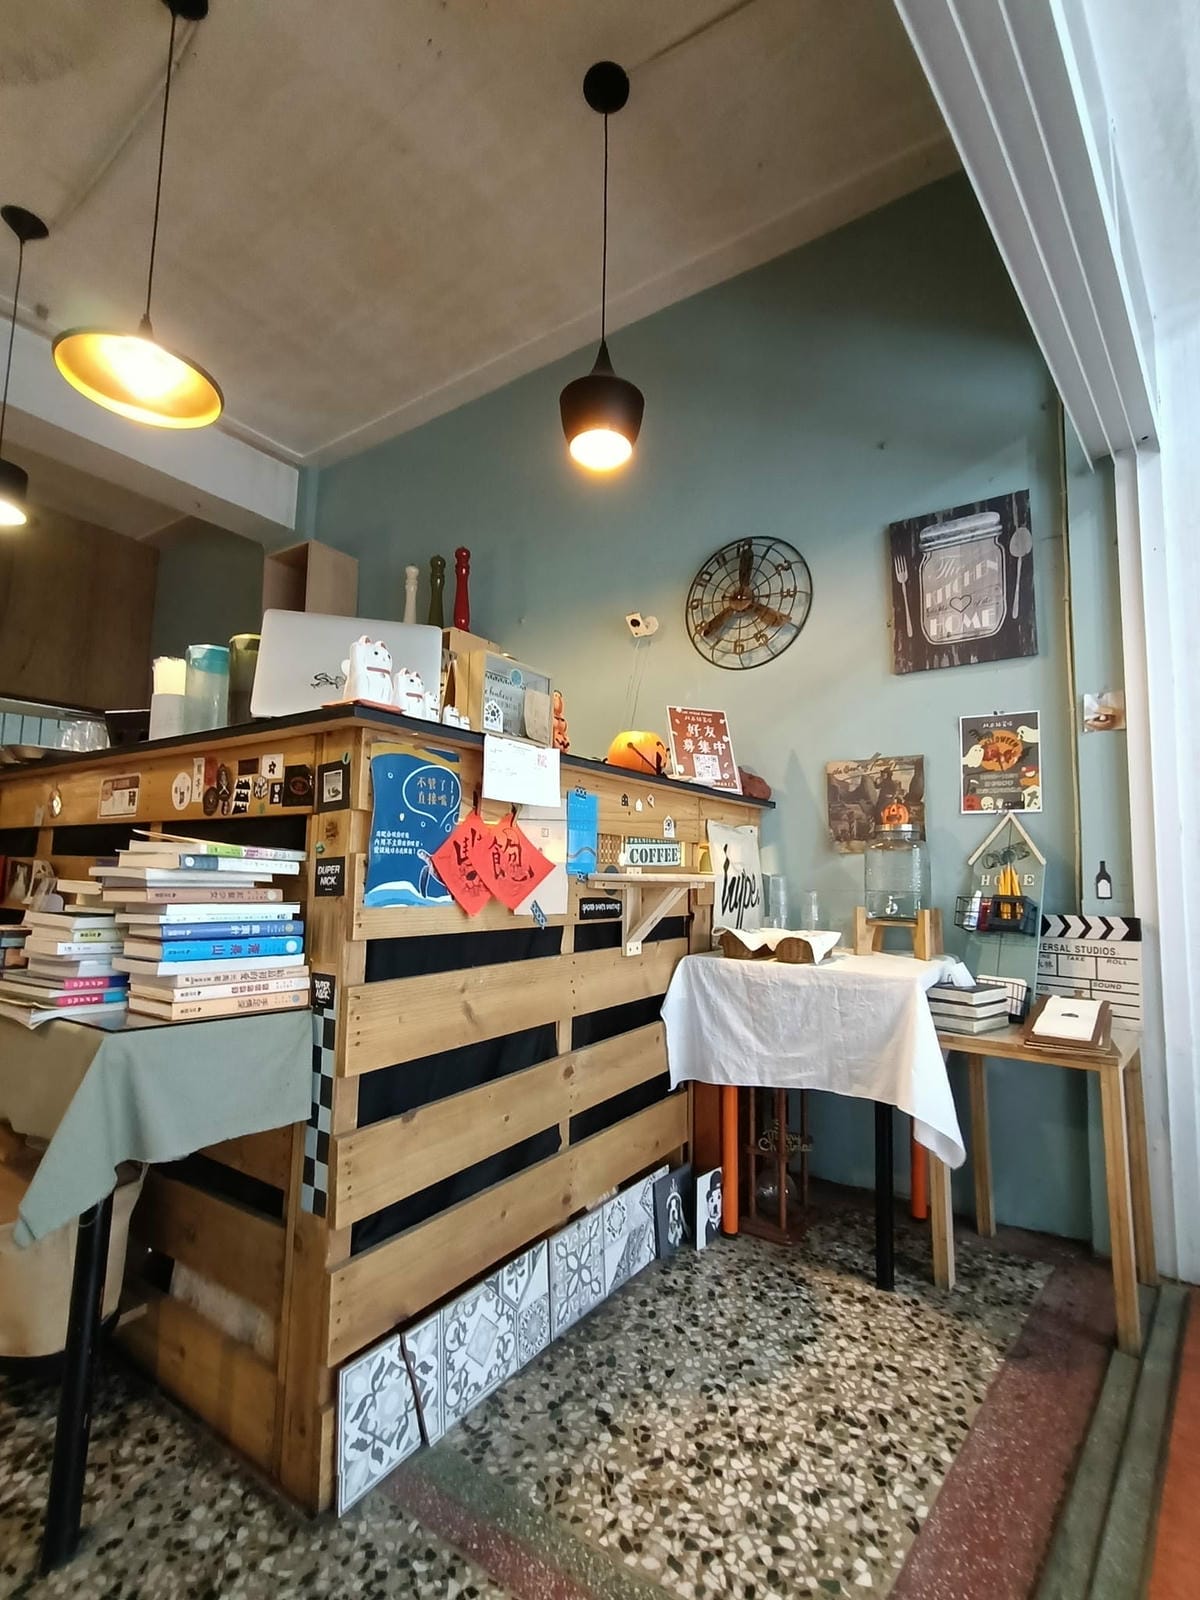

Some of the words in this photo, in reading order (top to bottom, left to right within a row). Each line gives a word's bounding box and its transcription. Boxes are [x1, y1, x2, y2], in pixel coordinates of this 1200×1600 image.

[930, 608, 996, 636] HOME
[687, 723, 716, 738] 好友
[682, 738, 726, 756] 募集中
[629, 847, 679, 864] COFFEE
[981, 874, 1035, 886] HOE
[1074, 945, 1116, 956] STUDIOS
[1106, 958, 1128, 966] ROLL
[1093, 982, 1122, 990] SOUND
